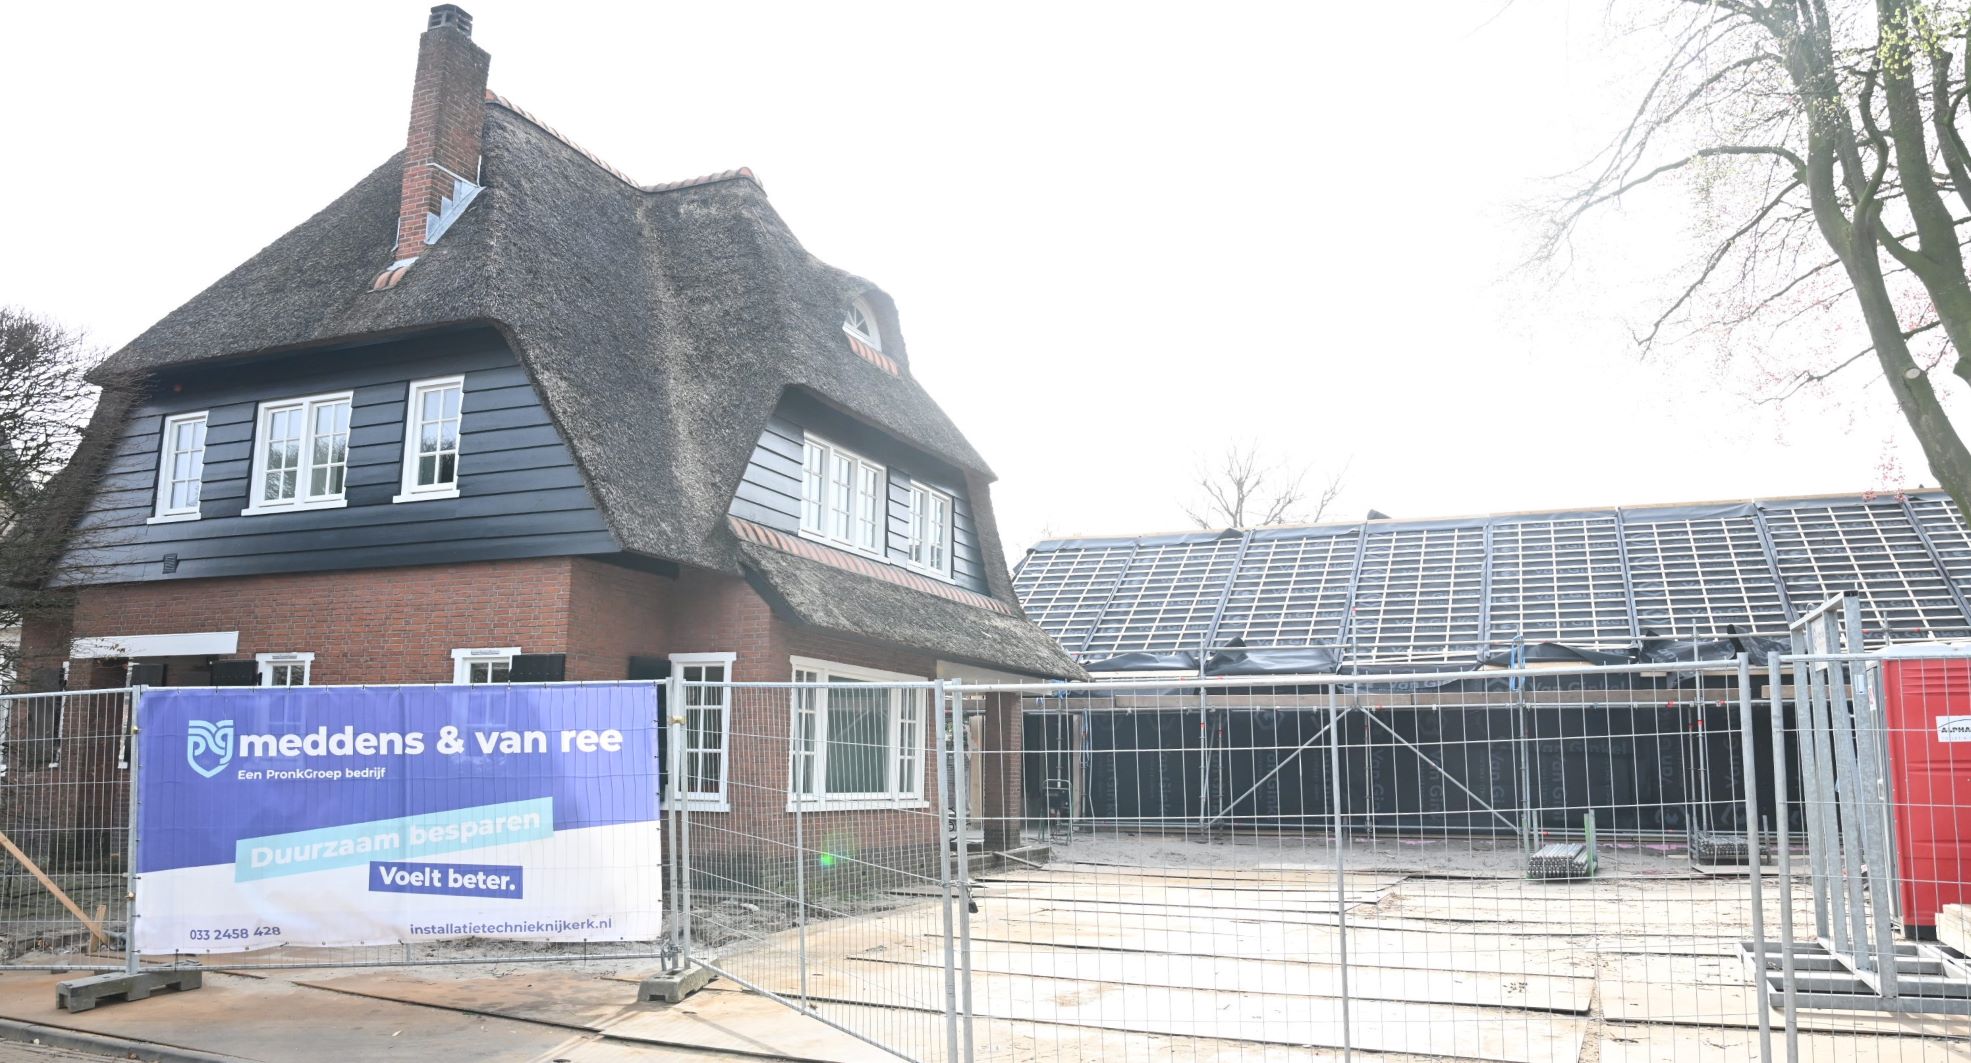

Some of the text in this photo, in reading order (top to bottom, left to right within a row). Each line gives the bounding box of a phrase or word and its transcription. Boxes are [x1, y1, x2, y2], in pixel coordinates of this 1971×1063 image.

[239, 725, 624, 757] meddens & van ree
[237, 766, 387, 780] Een PronkGroep bedrijf
[250, 812, 540, 868] Duurzaam besparen
[379, 865, 516, 891] Voelt beter.
[190, 926, 281, 940] 033 2458 428
[410, 918, 612, 935] installatietechnieknijkerk.nl
